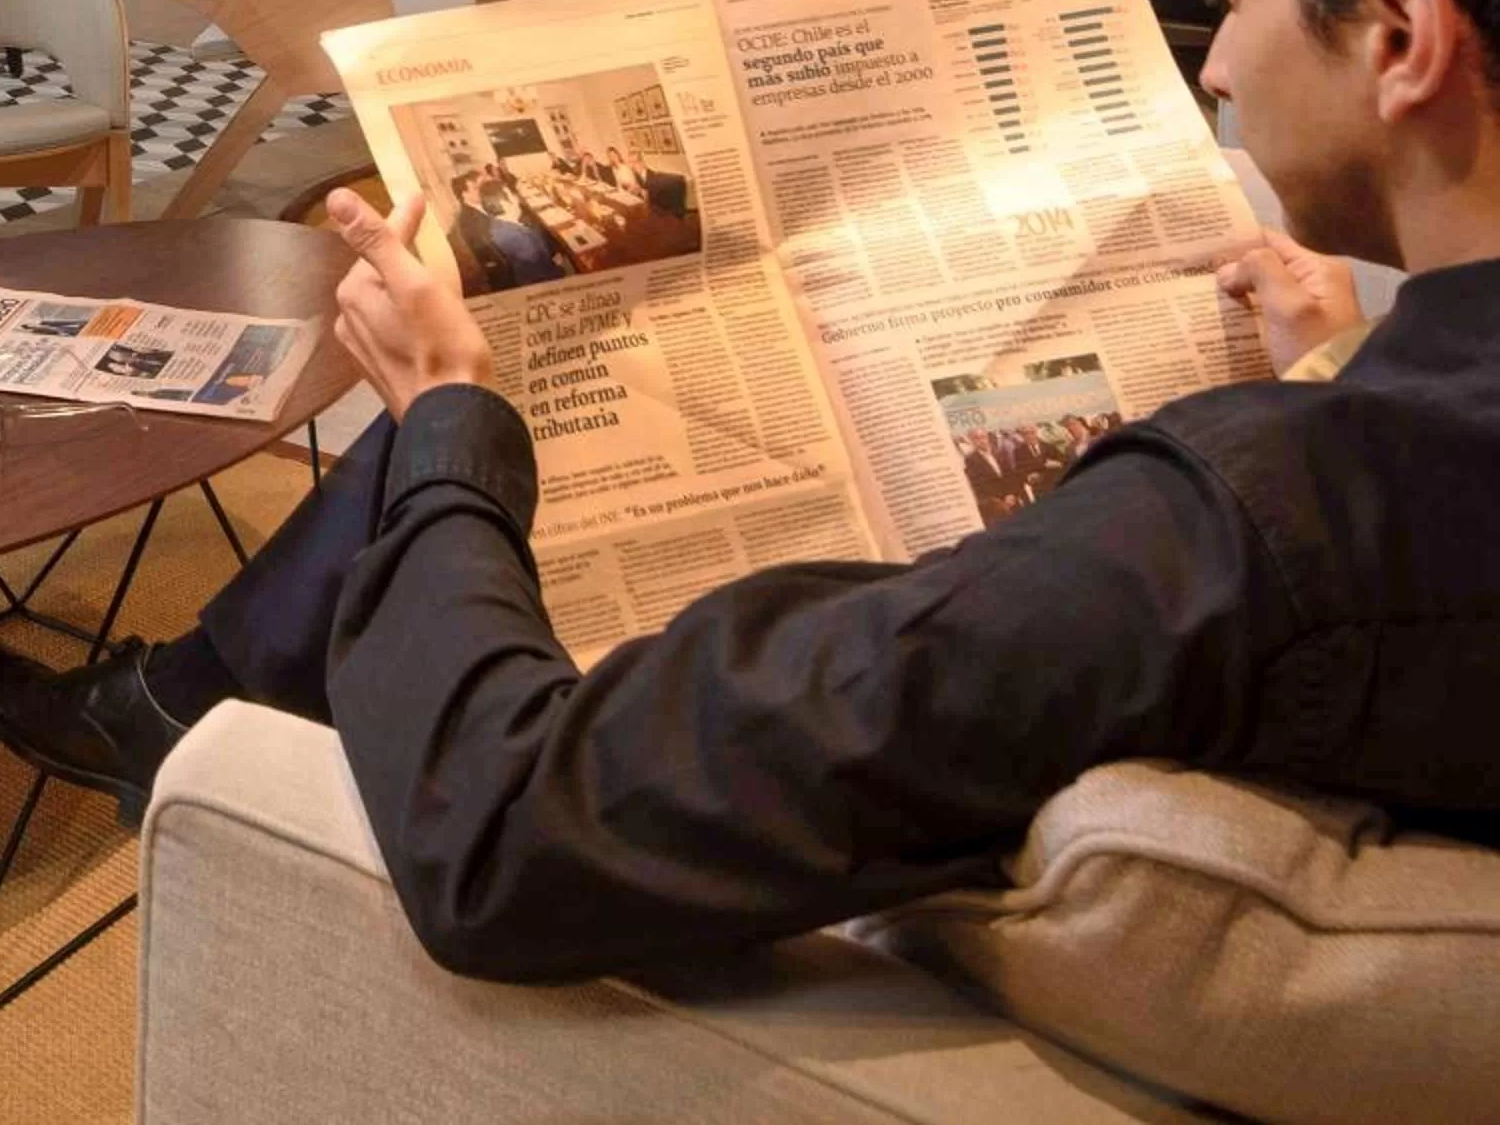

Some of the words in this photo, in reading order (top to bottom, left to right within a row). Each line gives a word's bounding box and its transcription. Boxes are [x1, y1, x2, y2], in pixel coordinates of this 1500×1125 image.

[737, 31, 788, 52] OCDE:
[792, 26, 832, 45] Chile
[835, 24, 852, 37] es
[856, 18, 870, 34] el
[743, 47, 814, 73] segundo
[818, 43, 851, 64] país
[855, 38, 885, 56] que
[833, 51, 905, 76] impuesto
[909, 51, 919, 63] a
[752, 83, 827, 107] empresas
[829, 74, 873, 94] desde
[876, 70, 892, 86] el
[894, 66, 933, 85] 2000
[560, 302, 575, 316] se
[930, 300, 993, 324] proyecto
[995, 294, 1022, 312] pro
[1025, 277, 1113, 303] consumidor
[1115, 275, 1140, 289] con
[526, 330, 553, 348] con
[556, 321, 577, 341] las
[621, 311, 632, 327] y
[527, 345, 586, 371] definen
[589, 331, 649, 360] puntos
[529, 378, 548, 394] en
[551, 360, 610, 388] común
[530, 400, 550, 418] en
[555, 384, 629, 411] reforma
[532, 407, 620, 442] tributaria
[666, 491, 719, 514] problema
[720, 486, 741, 501] que
